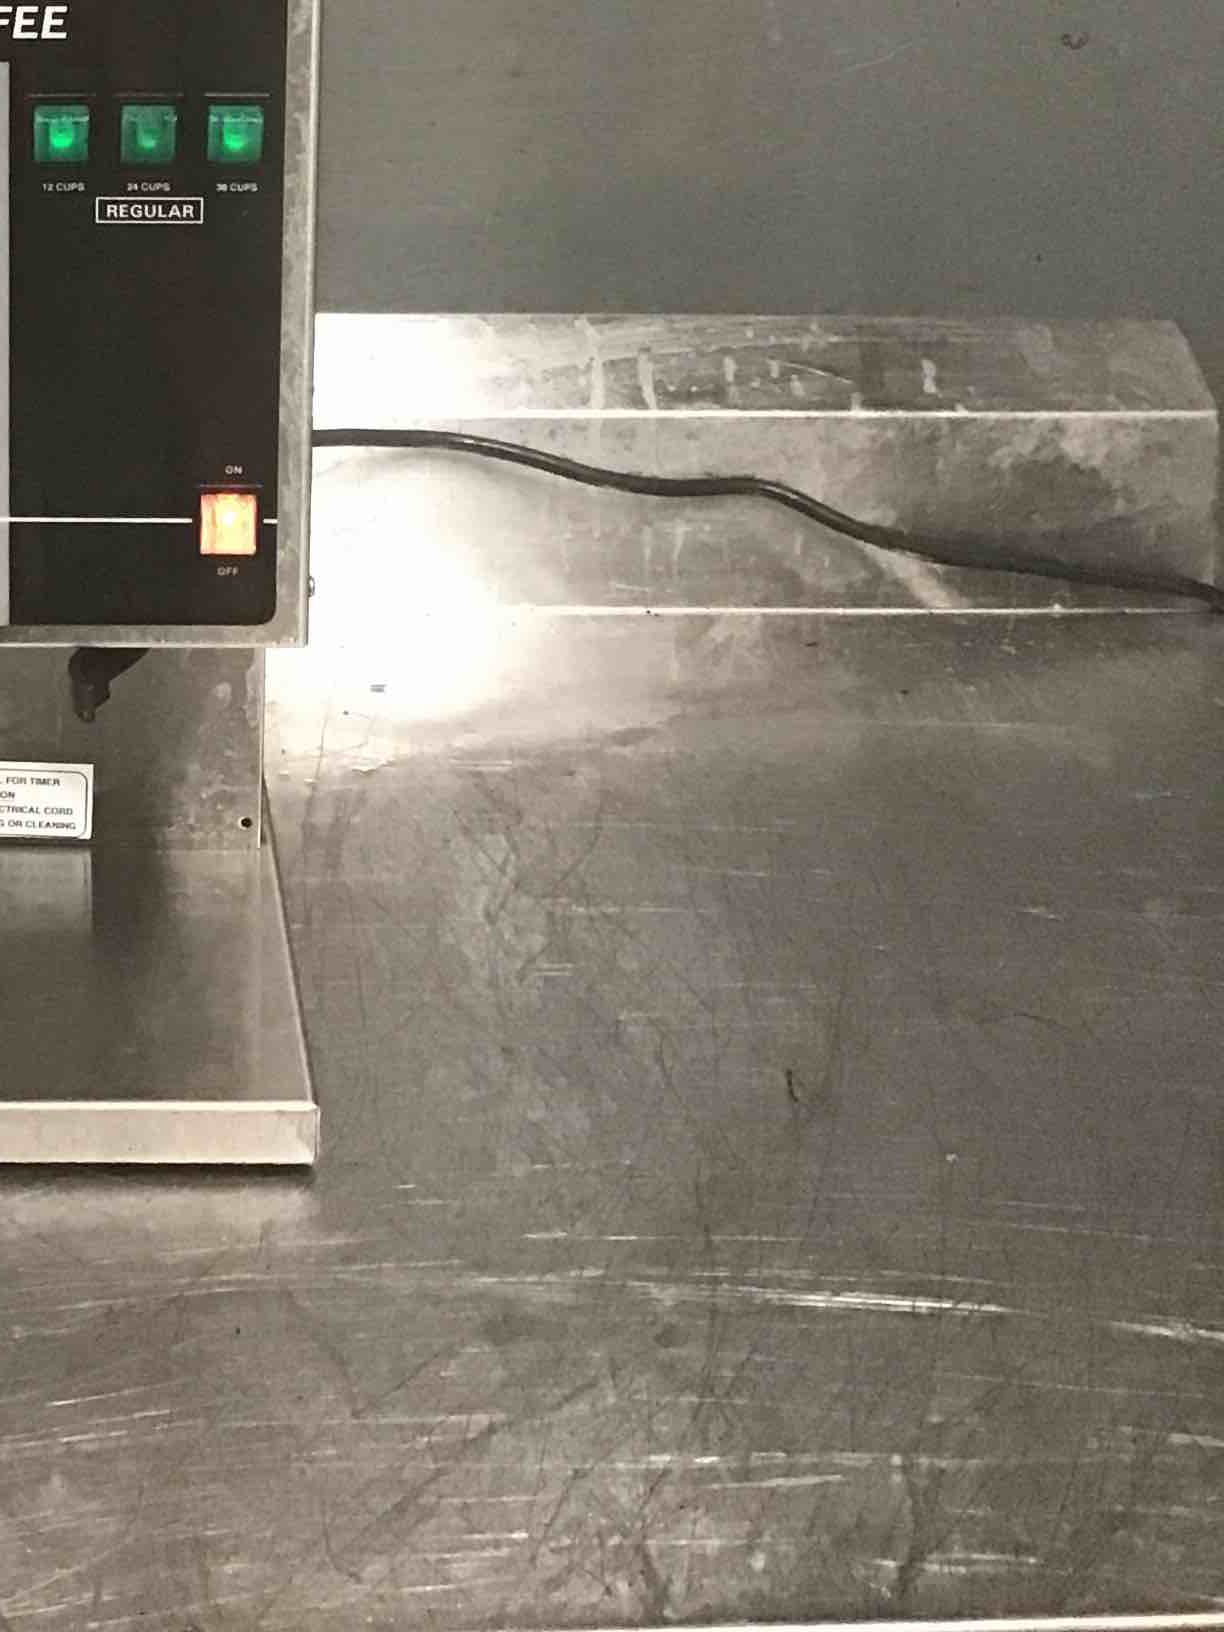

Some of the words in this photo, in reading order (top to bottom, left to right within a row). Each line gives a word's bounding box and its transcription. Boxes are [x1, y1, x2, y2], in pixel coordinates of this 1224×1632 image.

[43, 183, 54, 191] 12
[56, 183, 85, 191] CUPS
[127, 183, 139, 191] 24
[141, 183, 170, 191] CUPS
[230, 183, 258, 192] CUPS
[106, 205, 194, 218] REGULAR
[225, 465, 242, 474] ON
[217, 567, 238, 576] OFF
[6, 776, 27, 785] FOR
[30, 777, 61, 786] TIMER
[43, 807, 74, 816] CORD
[7, 820, 23, 829] OR
[25, 820, 76, 830] CLEANING
